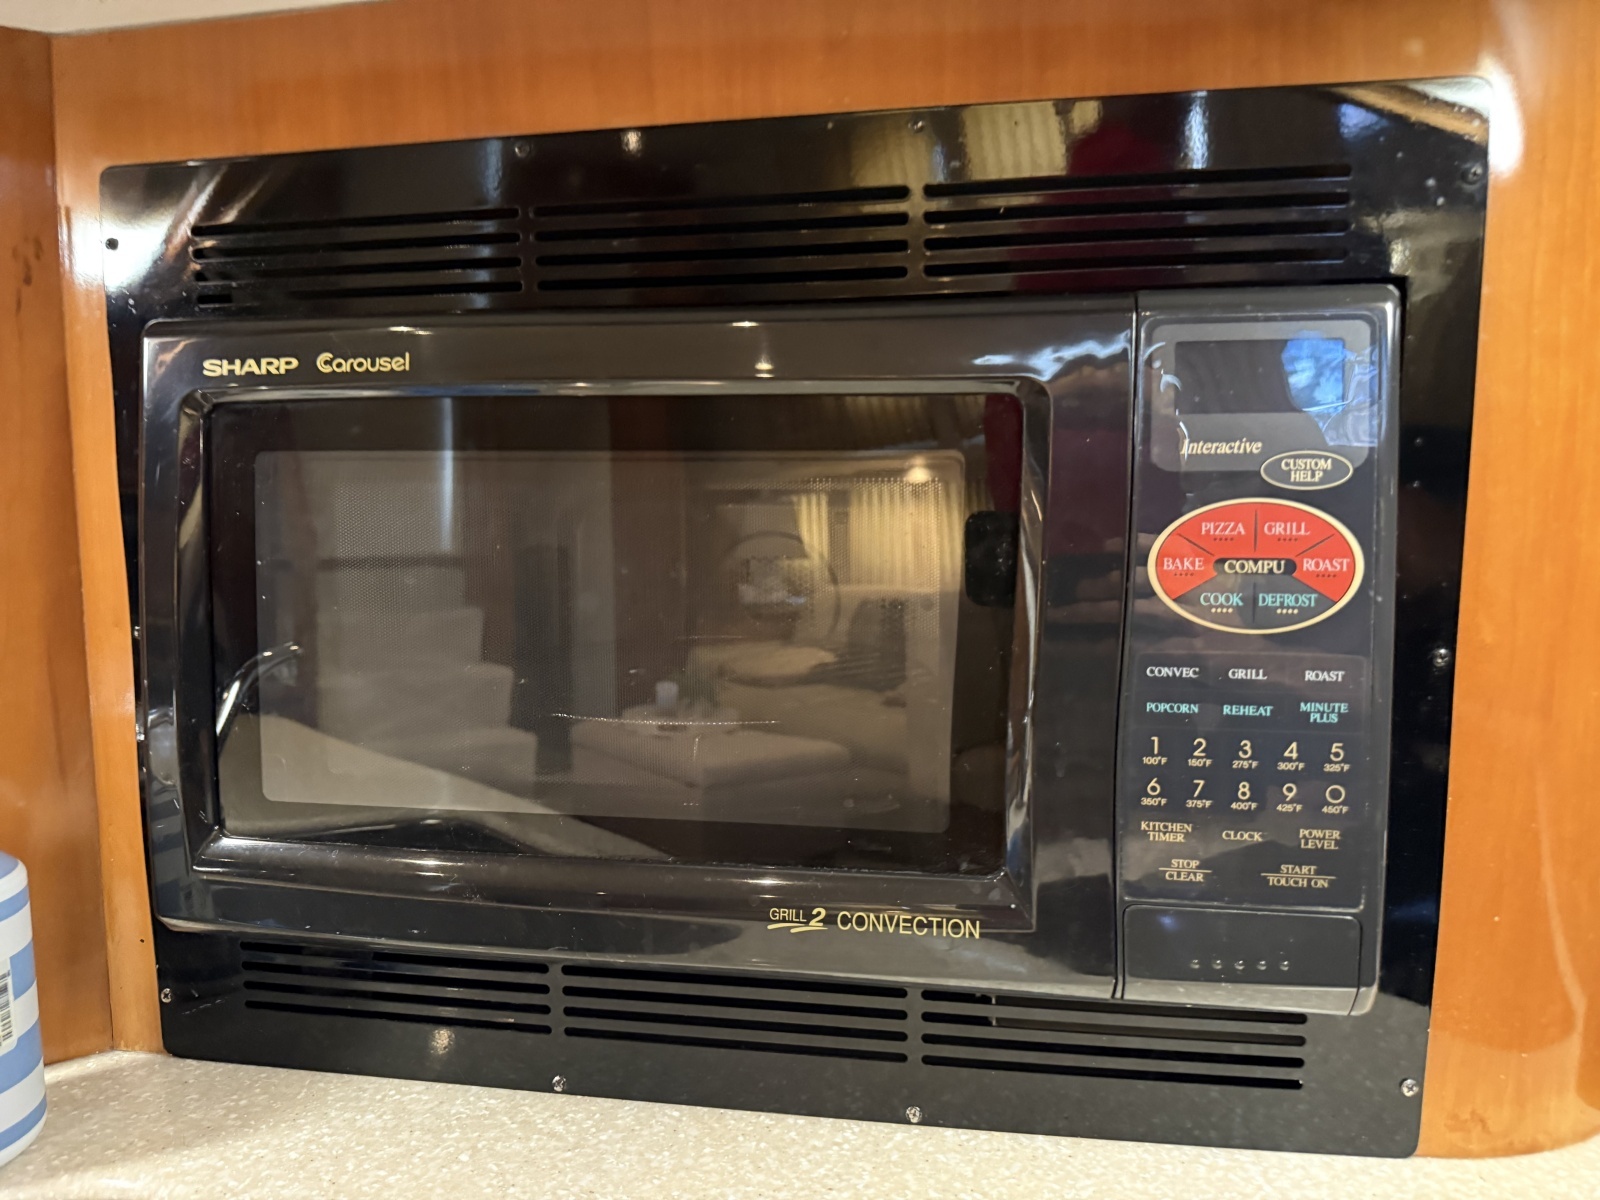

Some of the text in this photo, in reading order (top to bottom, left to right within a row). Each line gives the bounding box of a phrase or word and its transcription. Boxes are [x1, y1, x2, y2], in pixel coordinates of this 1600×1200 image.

[202, 351, 410, 377] SHARP Carousel
[1180, 437, 1263, 454] Interactive
[1281, 458, 1332, 470] CUSTOM
[1290, 470, 1323, 482] HELP
[1201, 521, 1246, 535] PIZZA
[1264, 522, 1311, 536] GRILL
[1163, 557, 1204, 571] BAKE
[1224, 560, 1285, 574] COMPU
[1302, 558, 1350, 572] ROAST
[1200, 592, 1243, 606] COOK
[1258, 593, 1318, 607] DEFROST
[1146, 666, 1200, 678] CONVEC
[1228, 668, 1268, 680] GRILL
[1304, 670, 1345, 682] ROAST
[1146, 702, 1199, 713] POPCORN
[1223, 705, 1274, 716] REHEAT
[1300, 702, 1349, 713] MINUTE
[1310, 712, 1338, 723] PLUS
[1150, 736, 1159, 755] 1
[1193, 738, 1207, 757] 2
[1238, 740, 1252, 759] 3
[1283, 741, 1298, 760] 4
[1329, 743, 1344, 762] 5
[1147, 778, 1161, 796] 6
[1193, 780, 1206, 798] 7
[1237, 781, 1250, 800] 8
[1282, 783, 1297, 801] 9
[1141, 821, 1193, 833] KITCHEN
[1147, 831, 1185, 843] TIMER
[1222, 831, 1262, 842] CLOCK
[1299, 829, 1341, 840] POWER
[1300, 839, 1338, 850] LEVEL
[1171, 859, 1200, 869] STOP
[1280, 864, 1317, 875] START
[1165, 871, 1204, 882] CLEAR
[1267, 876, 1329, 888] TOUCH ON
[769, 907, 980, 939] GRILL 2 CONVECTION
